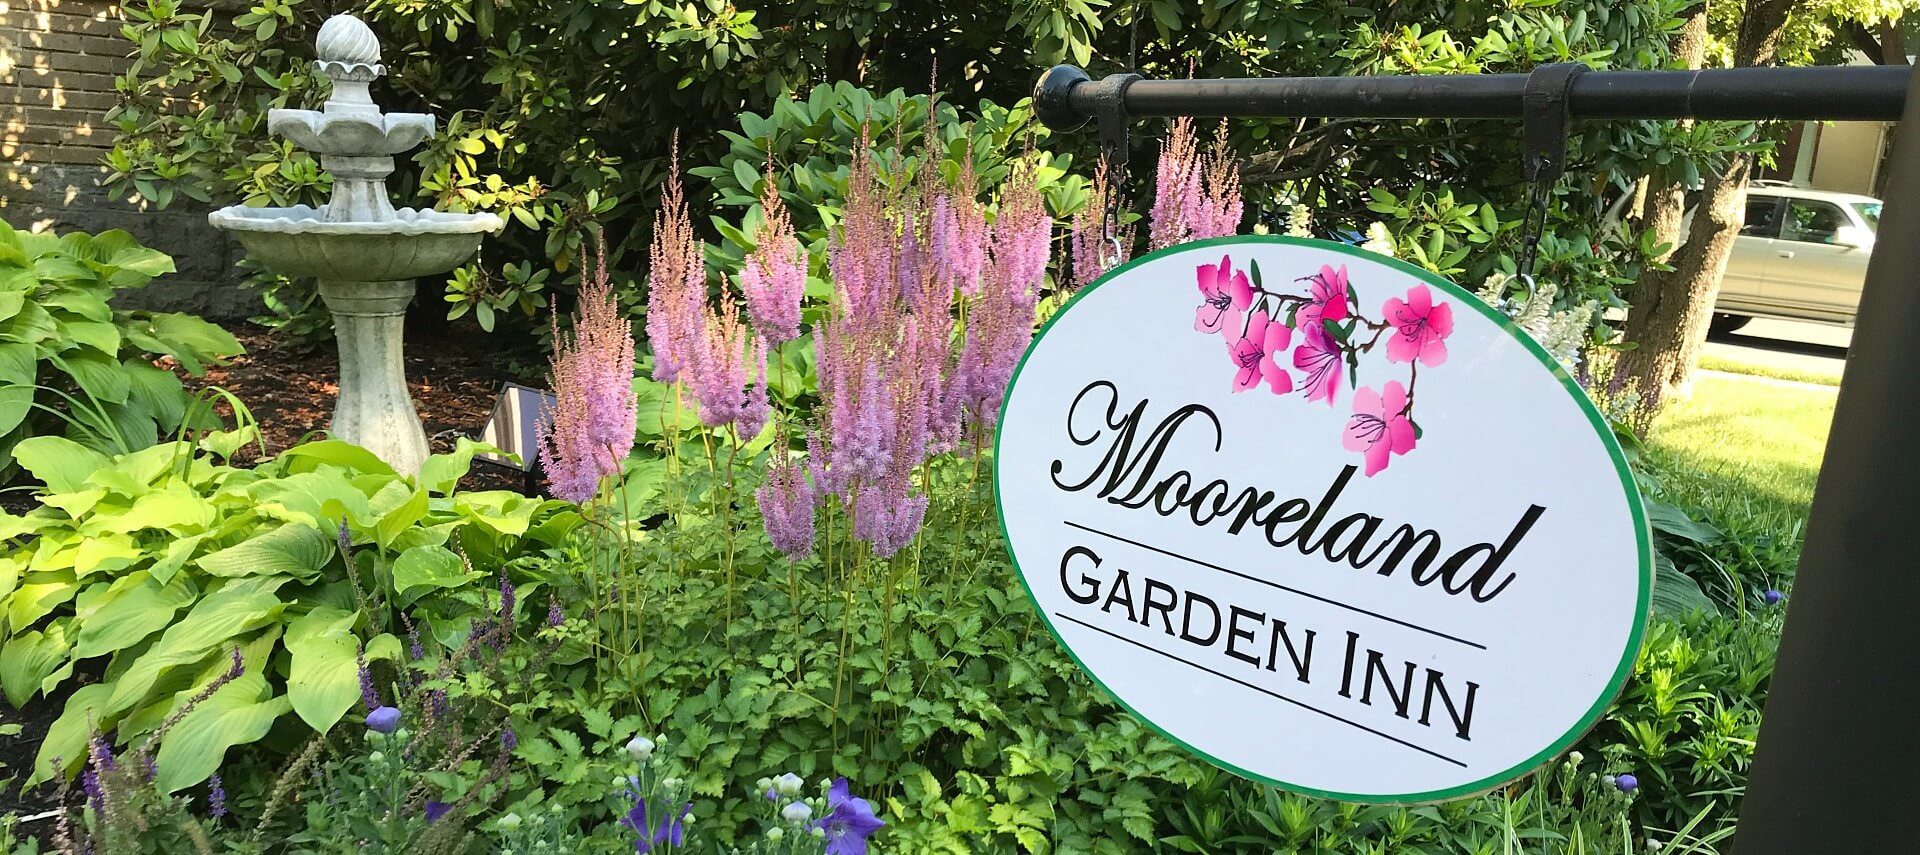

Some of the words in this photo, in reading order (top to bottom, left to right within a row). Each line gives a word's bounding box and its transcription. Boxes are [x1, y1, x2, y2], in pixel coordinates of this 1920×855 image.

[1051, 380, 1547, 604] Mooreland
[1059, 545, 1317, 685] GARDEN
[1337, 630, 1480, 742] INN
